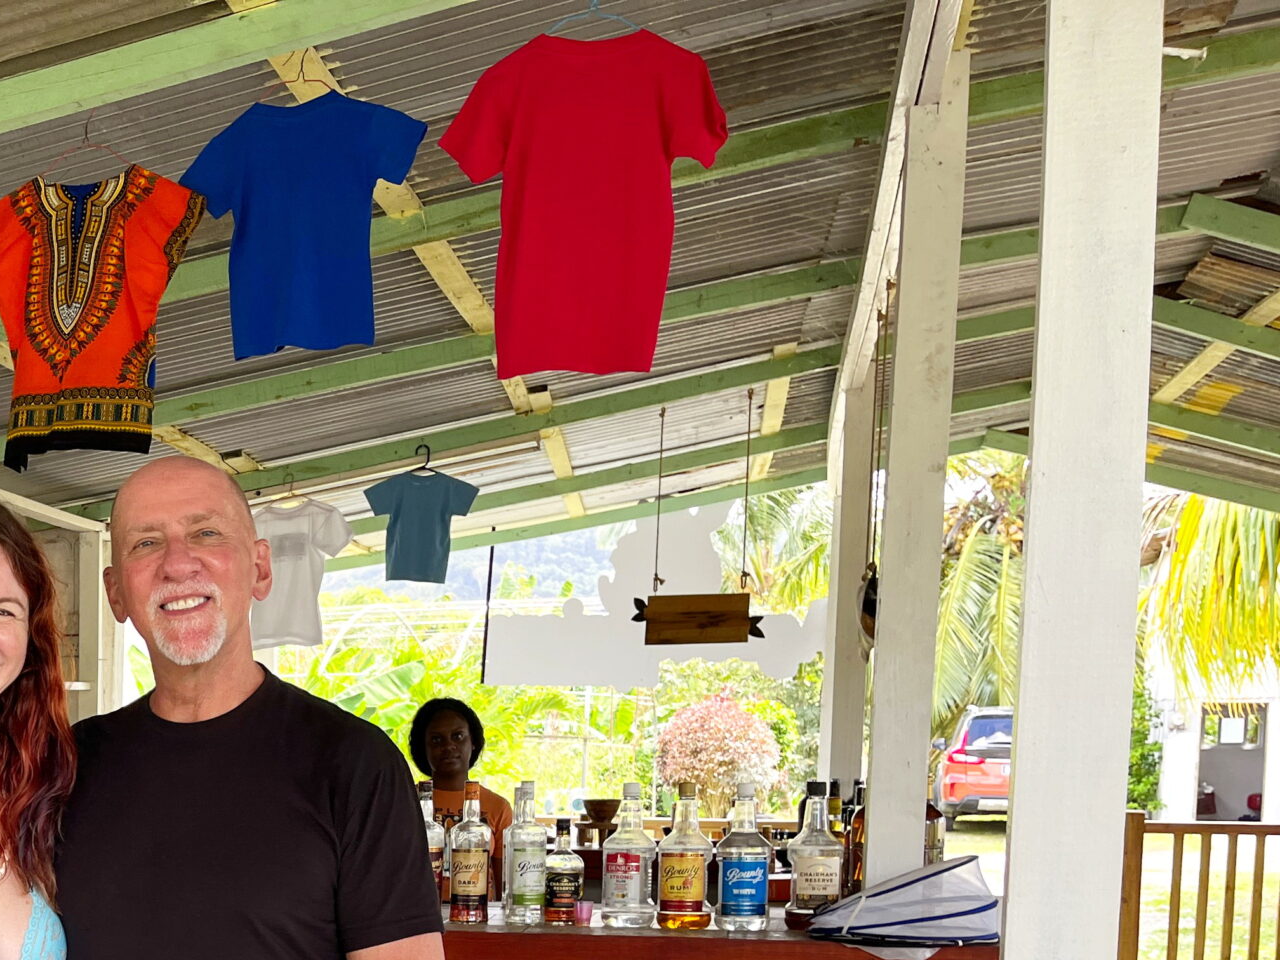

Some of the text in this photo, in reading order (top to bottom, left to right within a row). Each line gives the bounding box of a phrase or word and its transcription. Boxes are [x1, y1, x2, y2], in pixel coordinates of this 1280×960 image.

[453, 861, 485, 876] Bounty
[663, 864, 700, 882] Bounty
[725, 867, 765, 885] Bounty
